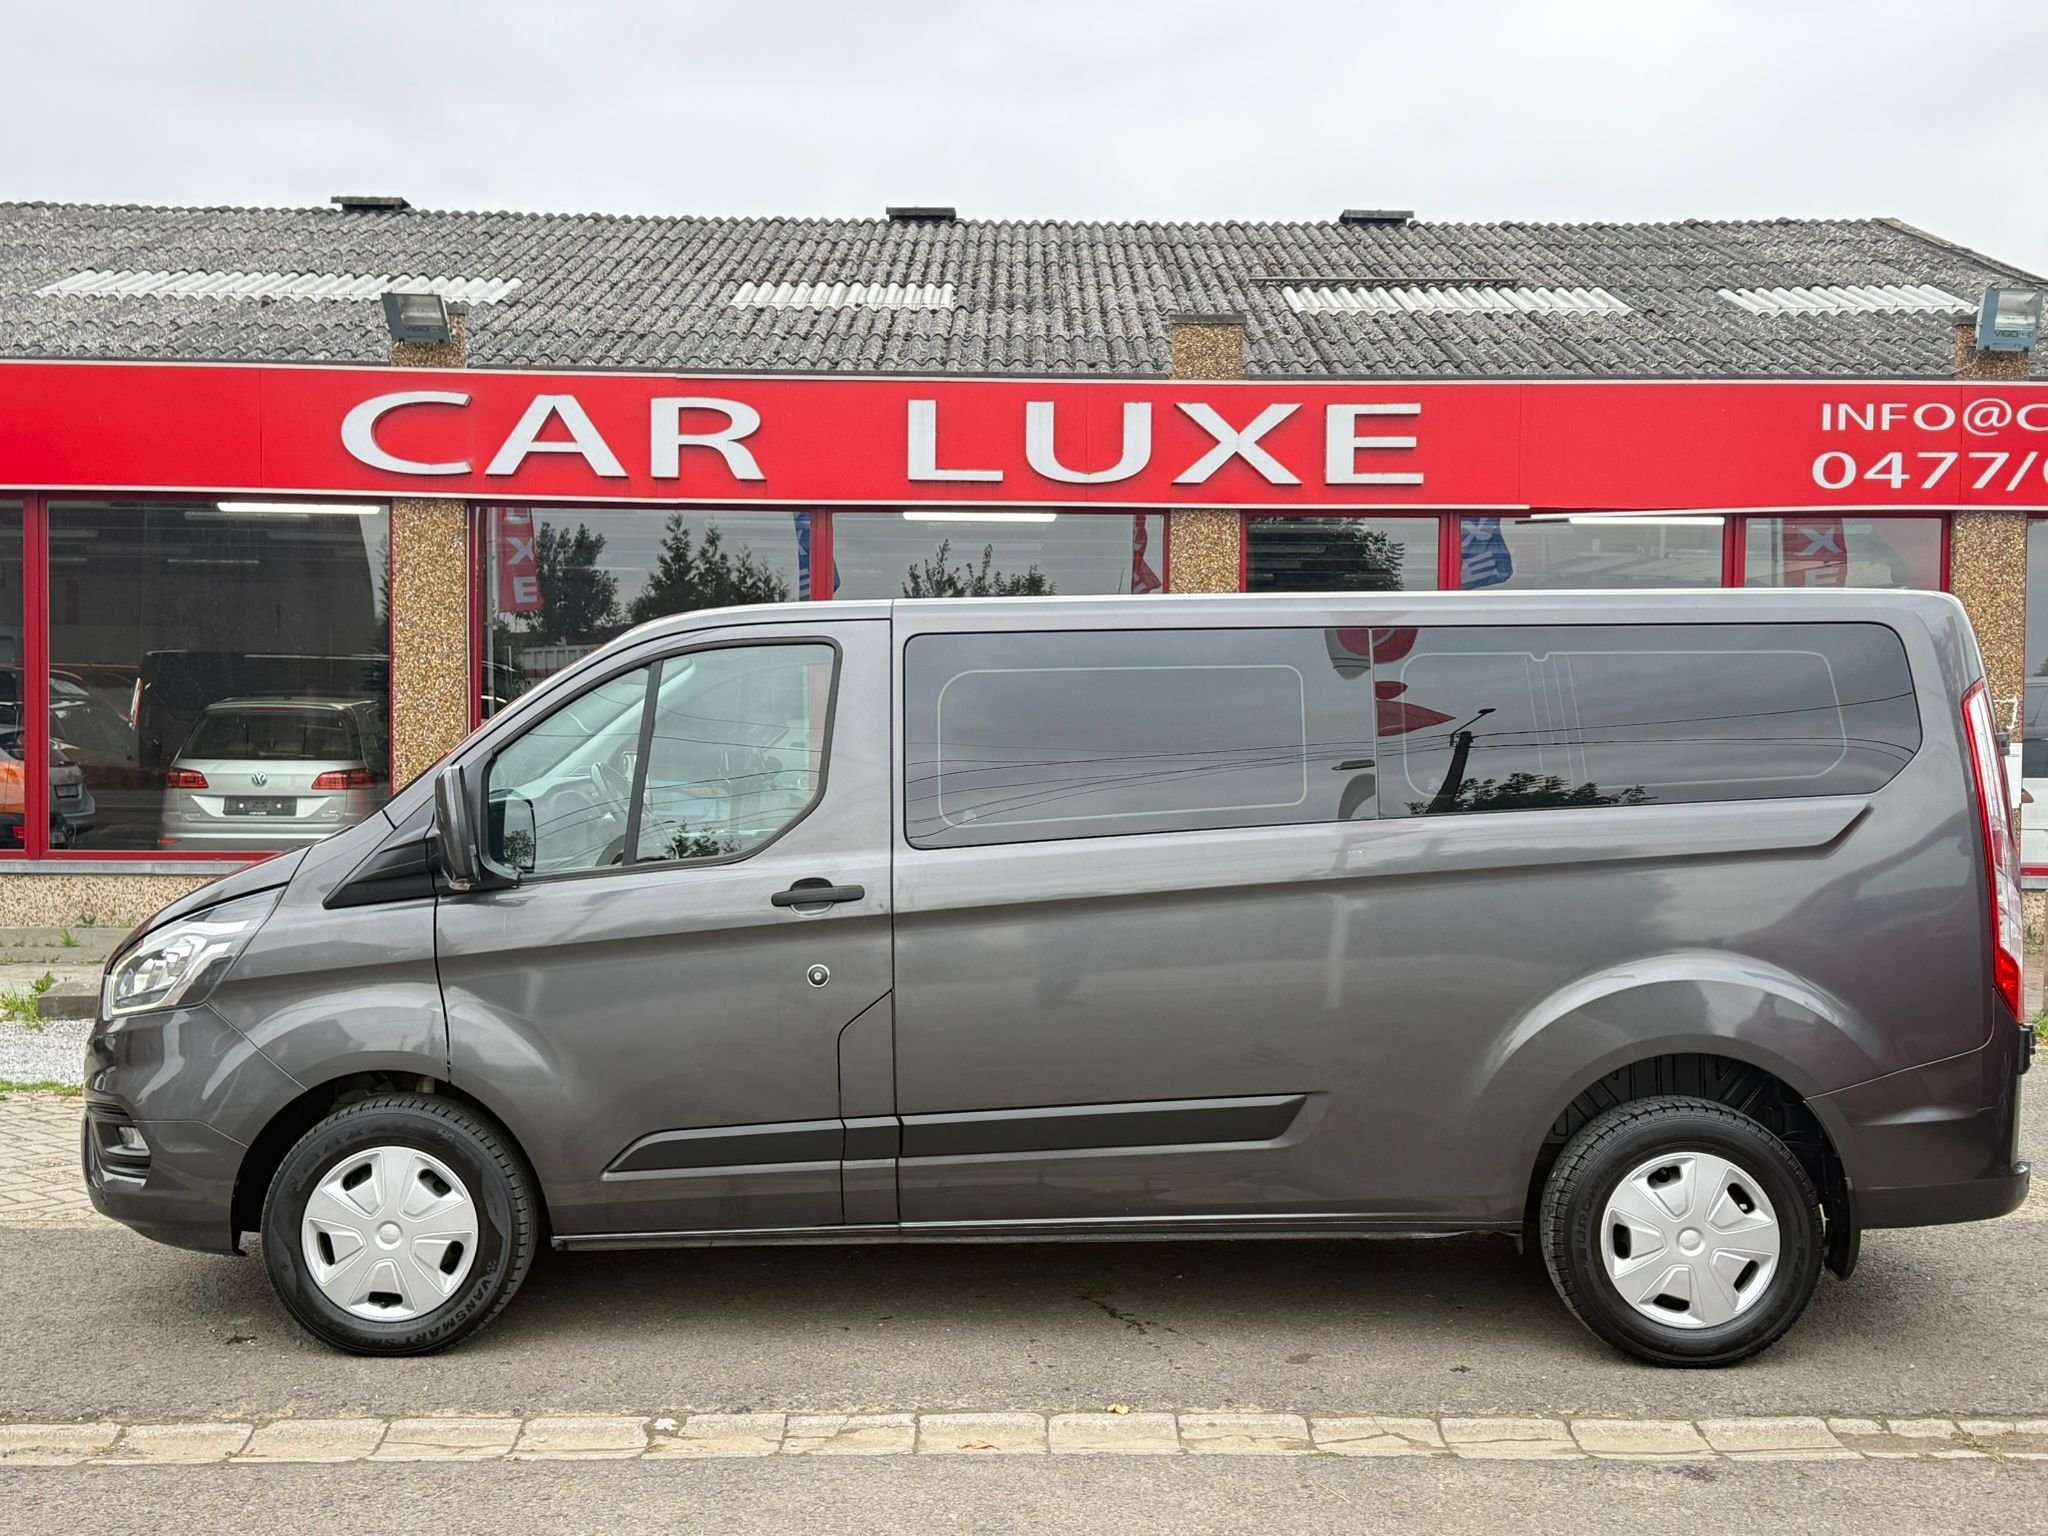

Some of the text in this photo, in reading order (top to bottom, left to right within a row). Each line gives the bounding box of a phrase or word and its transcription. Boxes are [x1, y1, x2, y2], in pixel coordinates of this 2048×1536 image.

[340, 390, 1424, 485] CAR LUXE
[1811, 451, 2048, 492] 0477/
